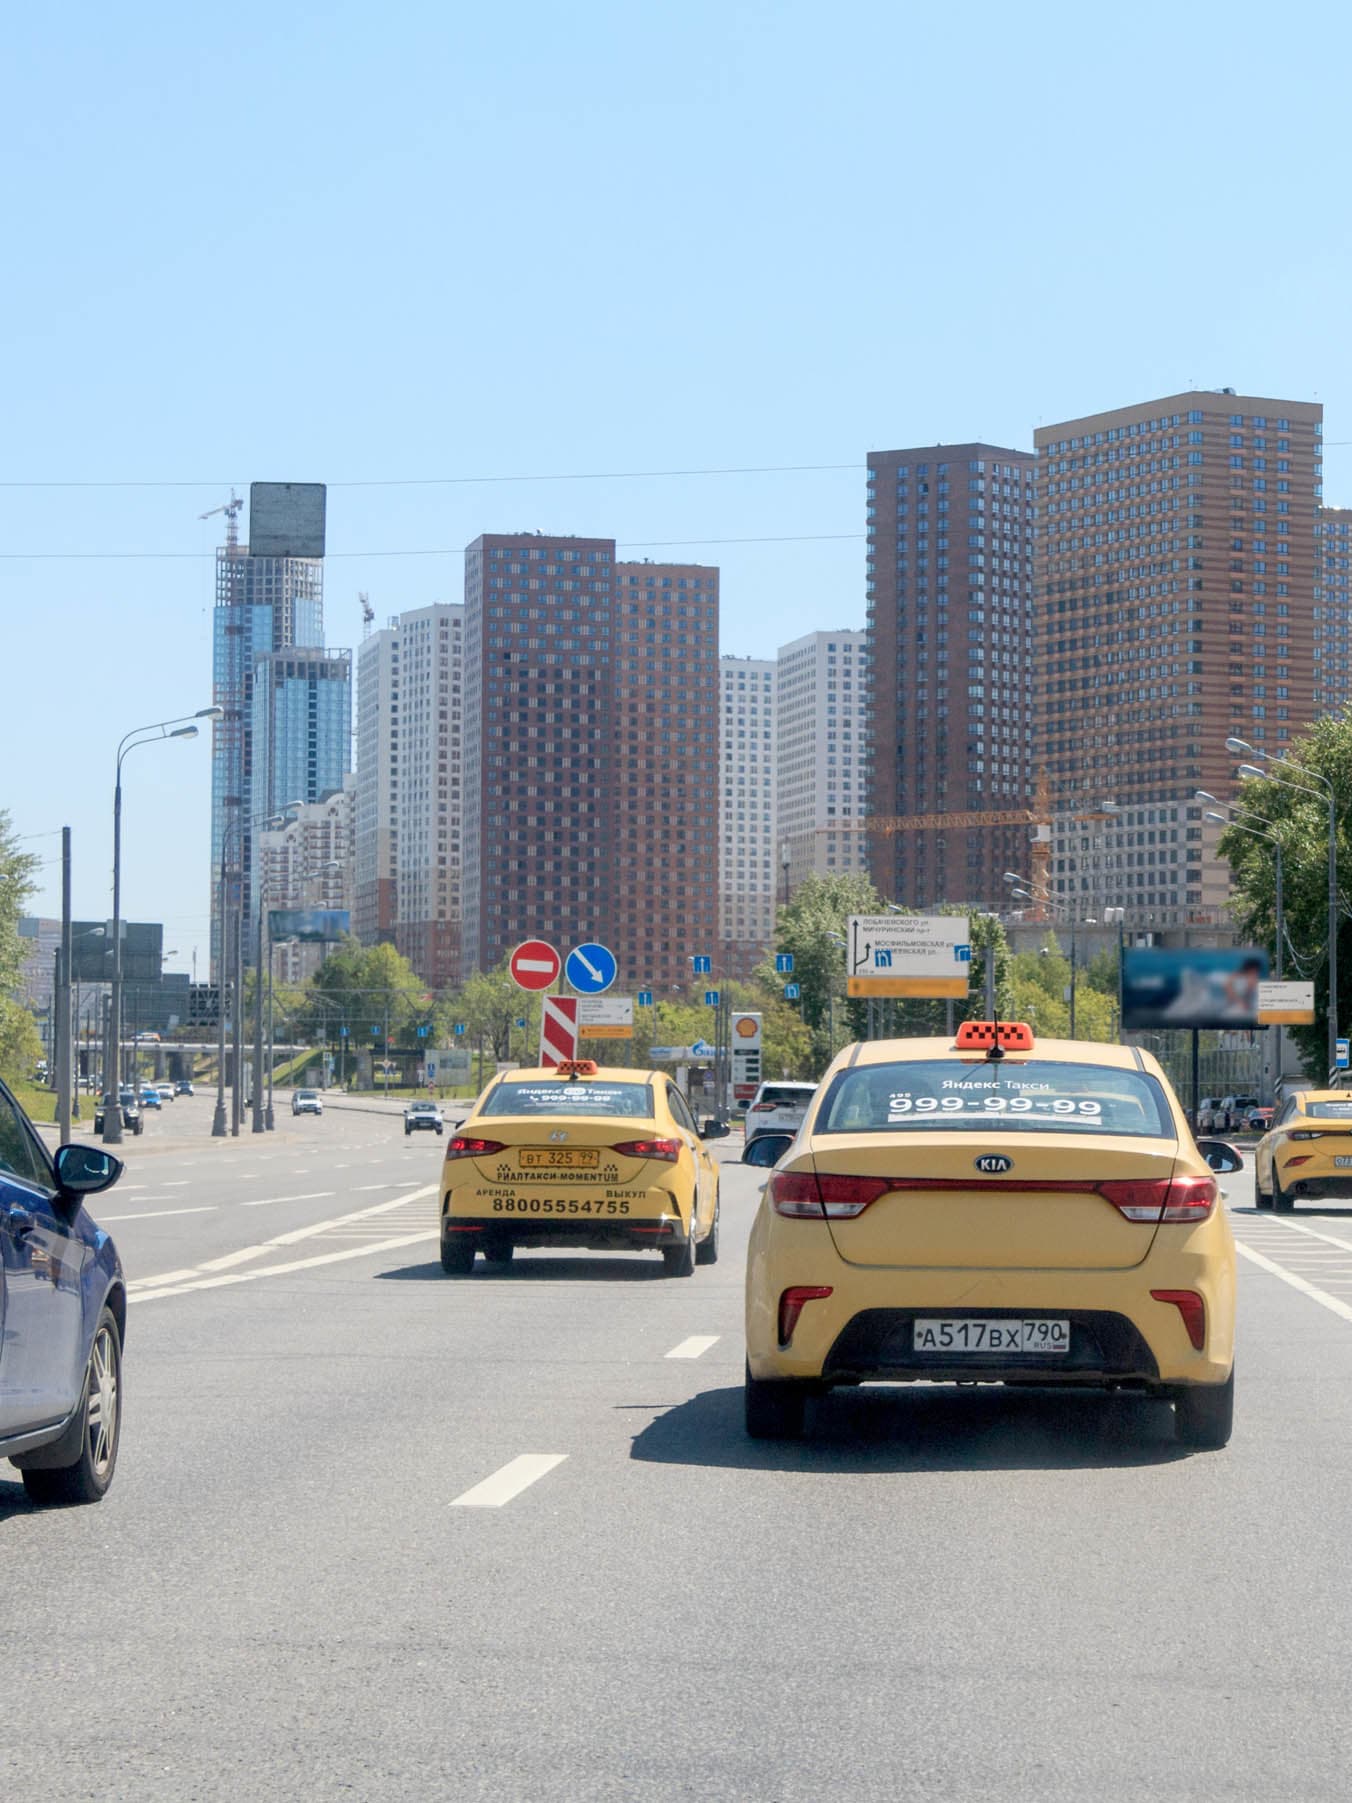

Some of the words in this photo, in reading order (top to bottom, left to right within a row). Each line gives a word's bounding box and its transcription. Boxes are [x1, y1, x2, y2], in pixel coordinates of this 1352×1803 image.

[942, 1080, 1000, 1090] Яндекс
[1004, 1080, 1049, 1090] Такси
[889, 1096, 1102, 1116] 999-99-99
[549, 1153, 573, 1164] 325
[580, 1152, 593, 1161] 99
[980, 1159, 1007, 1170] KIA
[476, 1189, 516, 1197] АРЕНДА
[606, 1190, 646, 1198] ВЫКУП
[493, 1198, 630, 1214] 88005554755
[922, 1323, 1020, 1348] А517ВХ
[1024, 1323, 1062, 1341] 790
